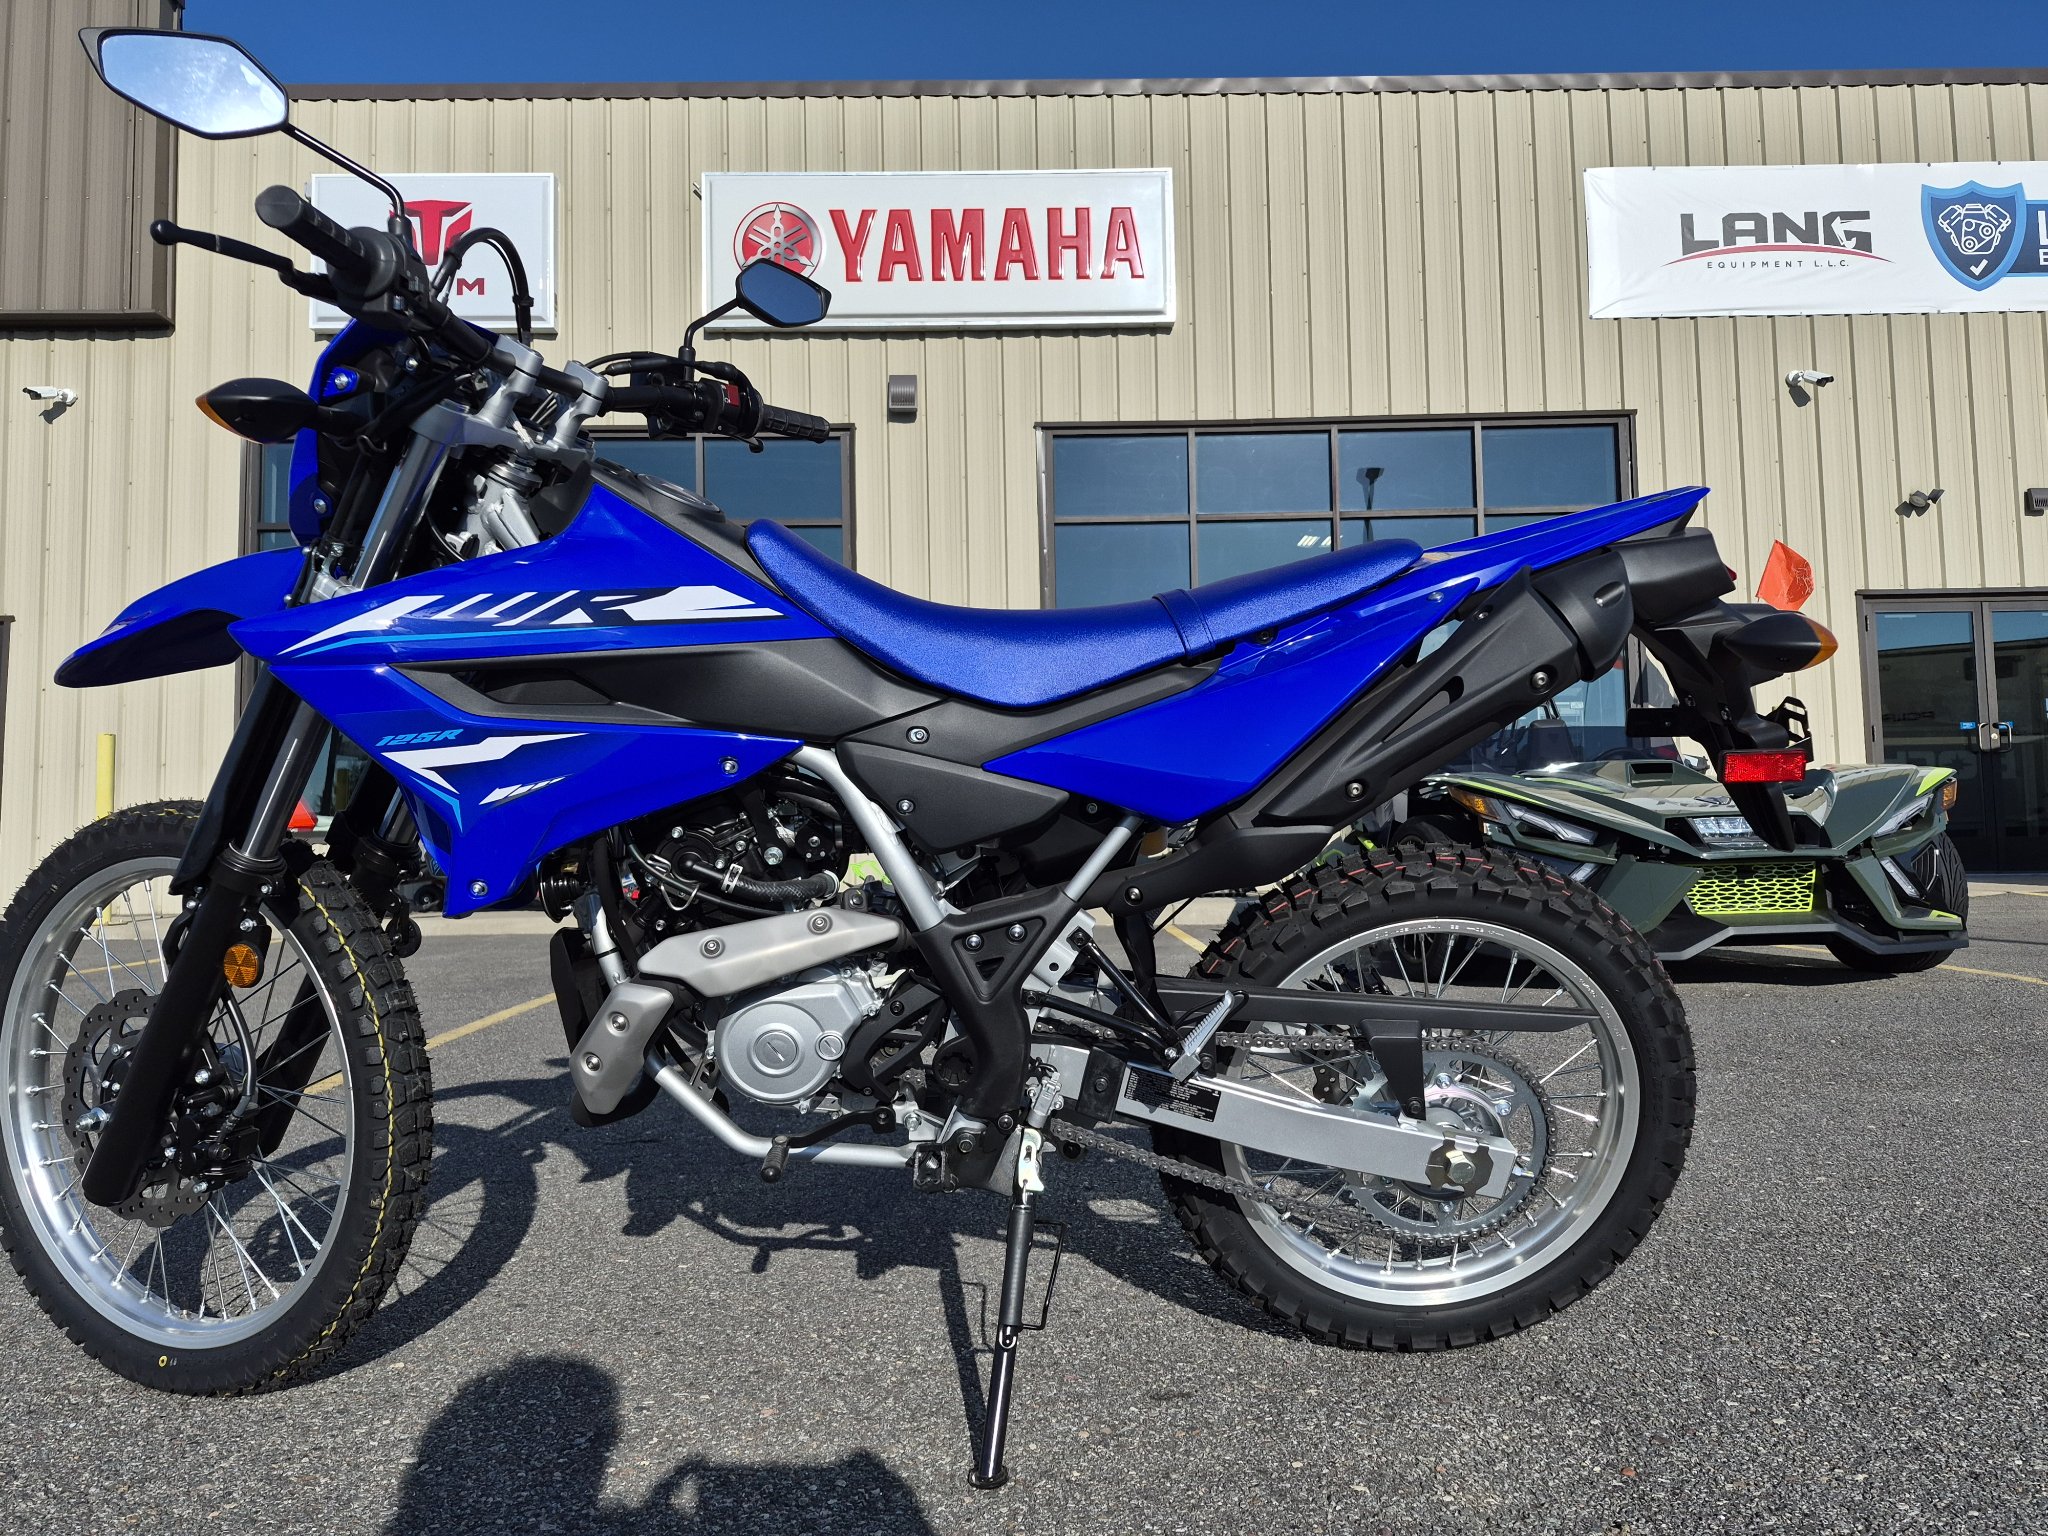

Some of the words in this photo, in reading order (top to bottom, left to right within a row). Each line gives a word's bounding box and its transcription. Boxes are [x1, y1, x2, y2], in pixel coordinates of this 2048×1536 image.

[828, 206, 1145, 283] YAMAHA
[1680, 210, 1873, 256] LANG
[1707, 260, 1804, 269] EQUIPMENT
[375, 728, 464, 747] 125R
